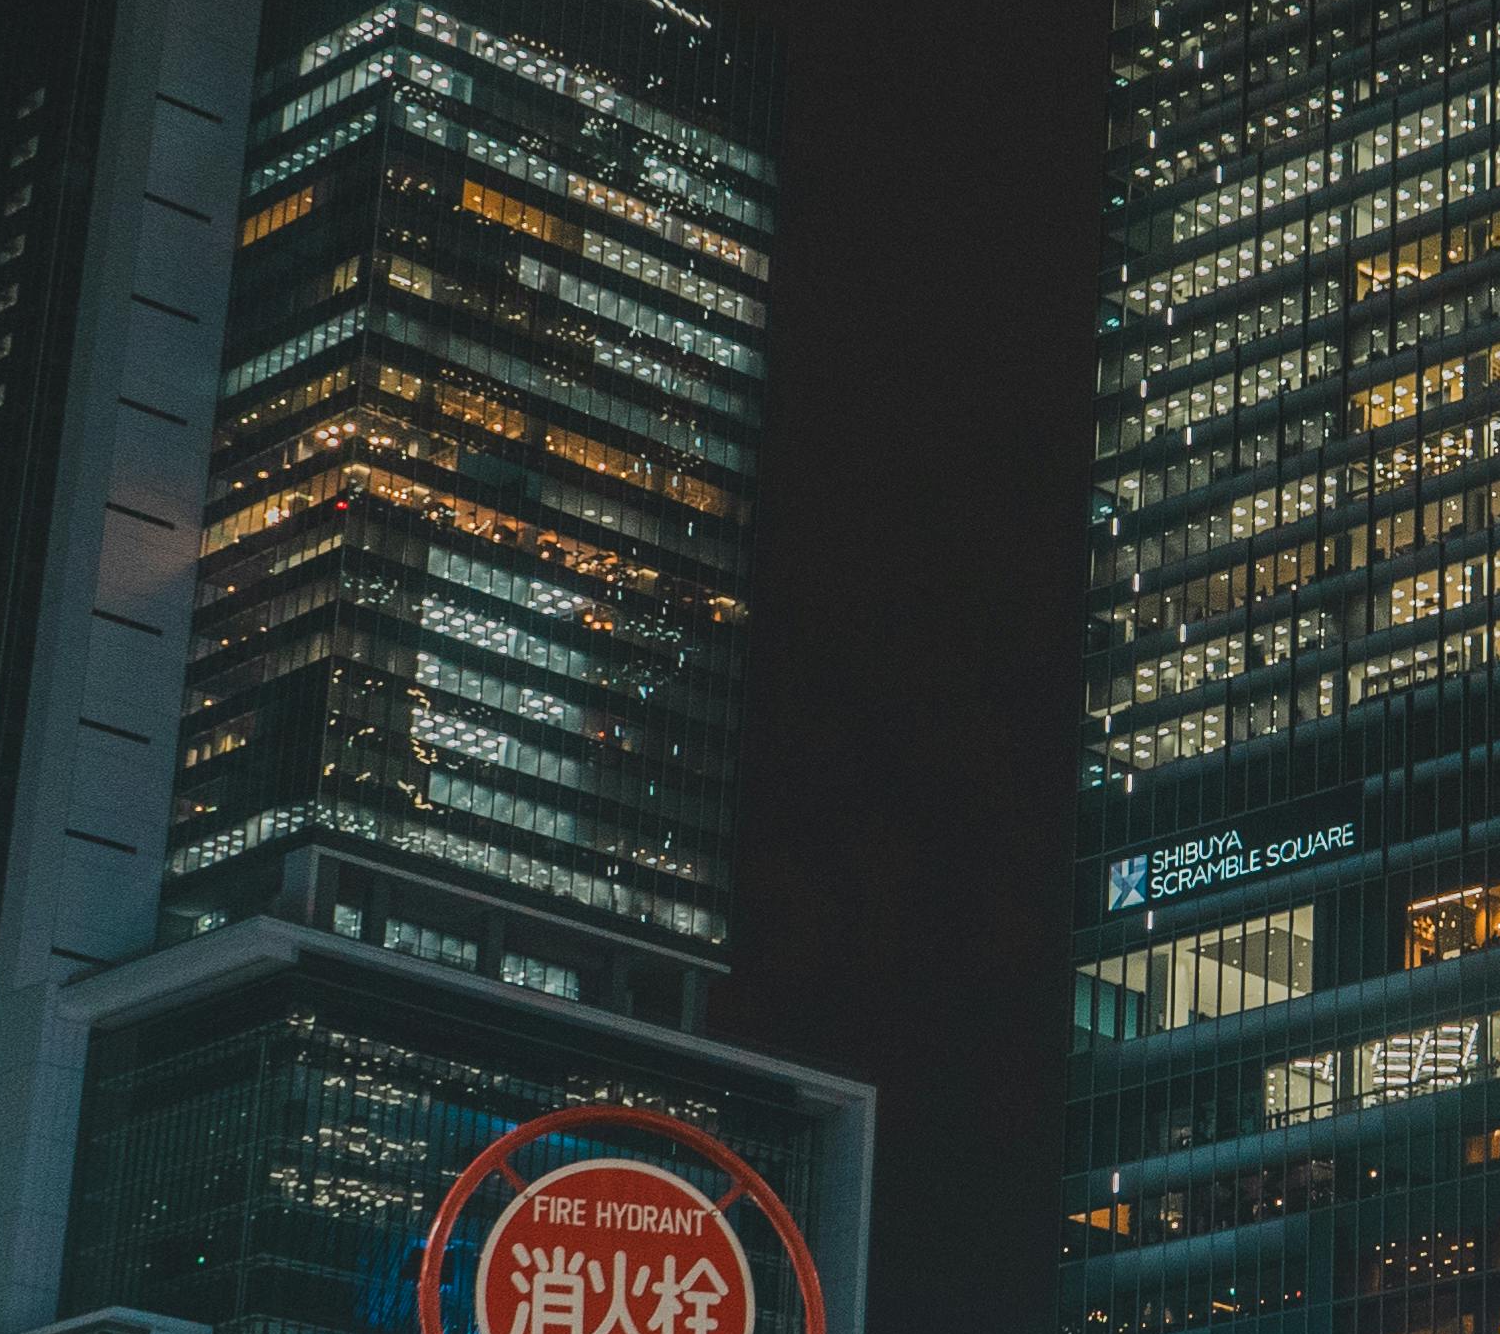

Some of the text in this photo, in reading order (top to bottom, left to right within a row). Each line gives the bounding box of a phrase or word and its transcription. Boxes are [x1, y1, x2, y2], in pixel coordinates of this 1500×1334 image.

[1150, 822, 1355, 899] SCRAMBLE SQUARE
[1151, 829, 1243, 874] SHIBUYA
[532, 1194, 707, 1238] FIRE HYDRANT
